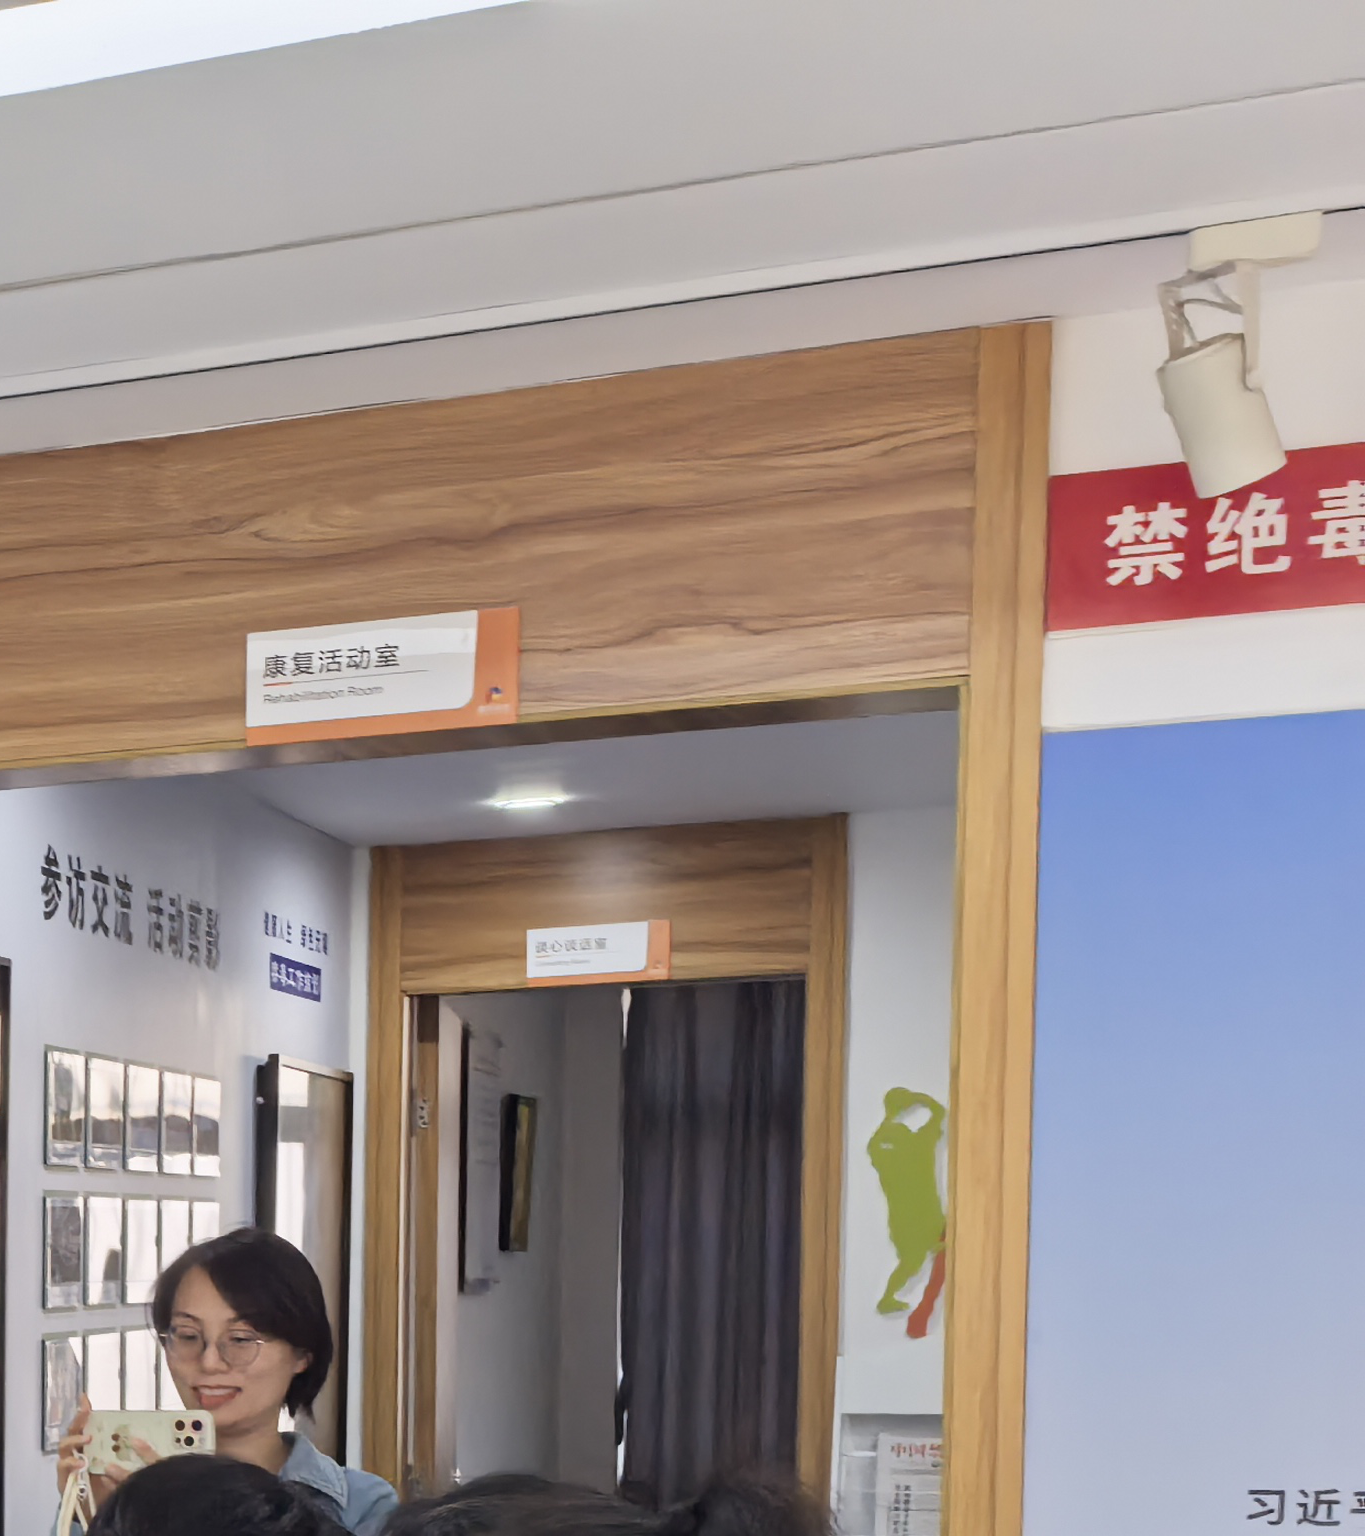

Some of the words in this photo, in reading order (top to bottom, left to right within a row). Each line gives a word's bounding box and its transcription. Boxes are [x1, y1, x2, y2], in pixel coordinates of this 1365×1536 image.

[263, 644, 400, 678] 康复活动室
[347, 685, 384, 696] Room
